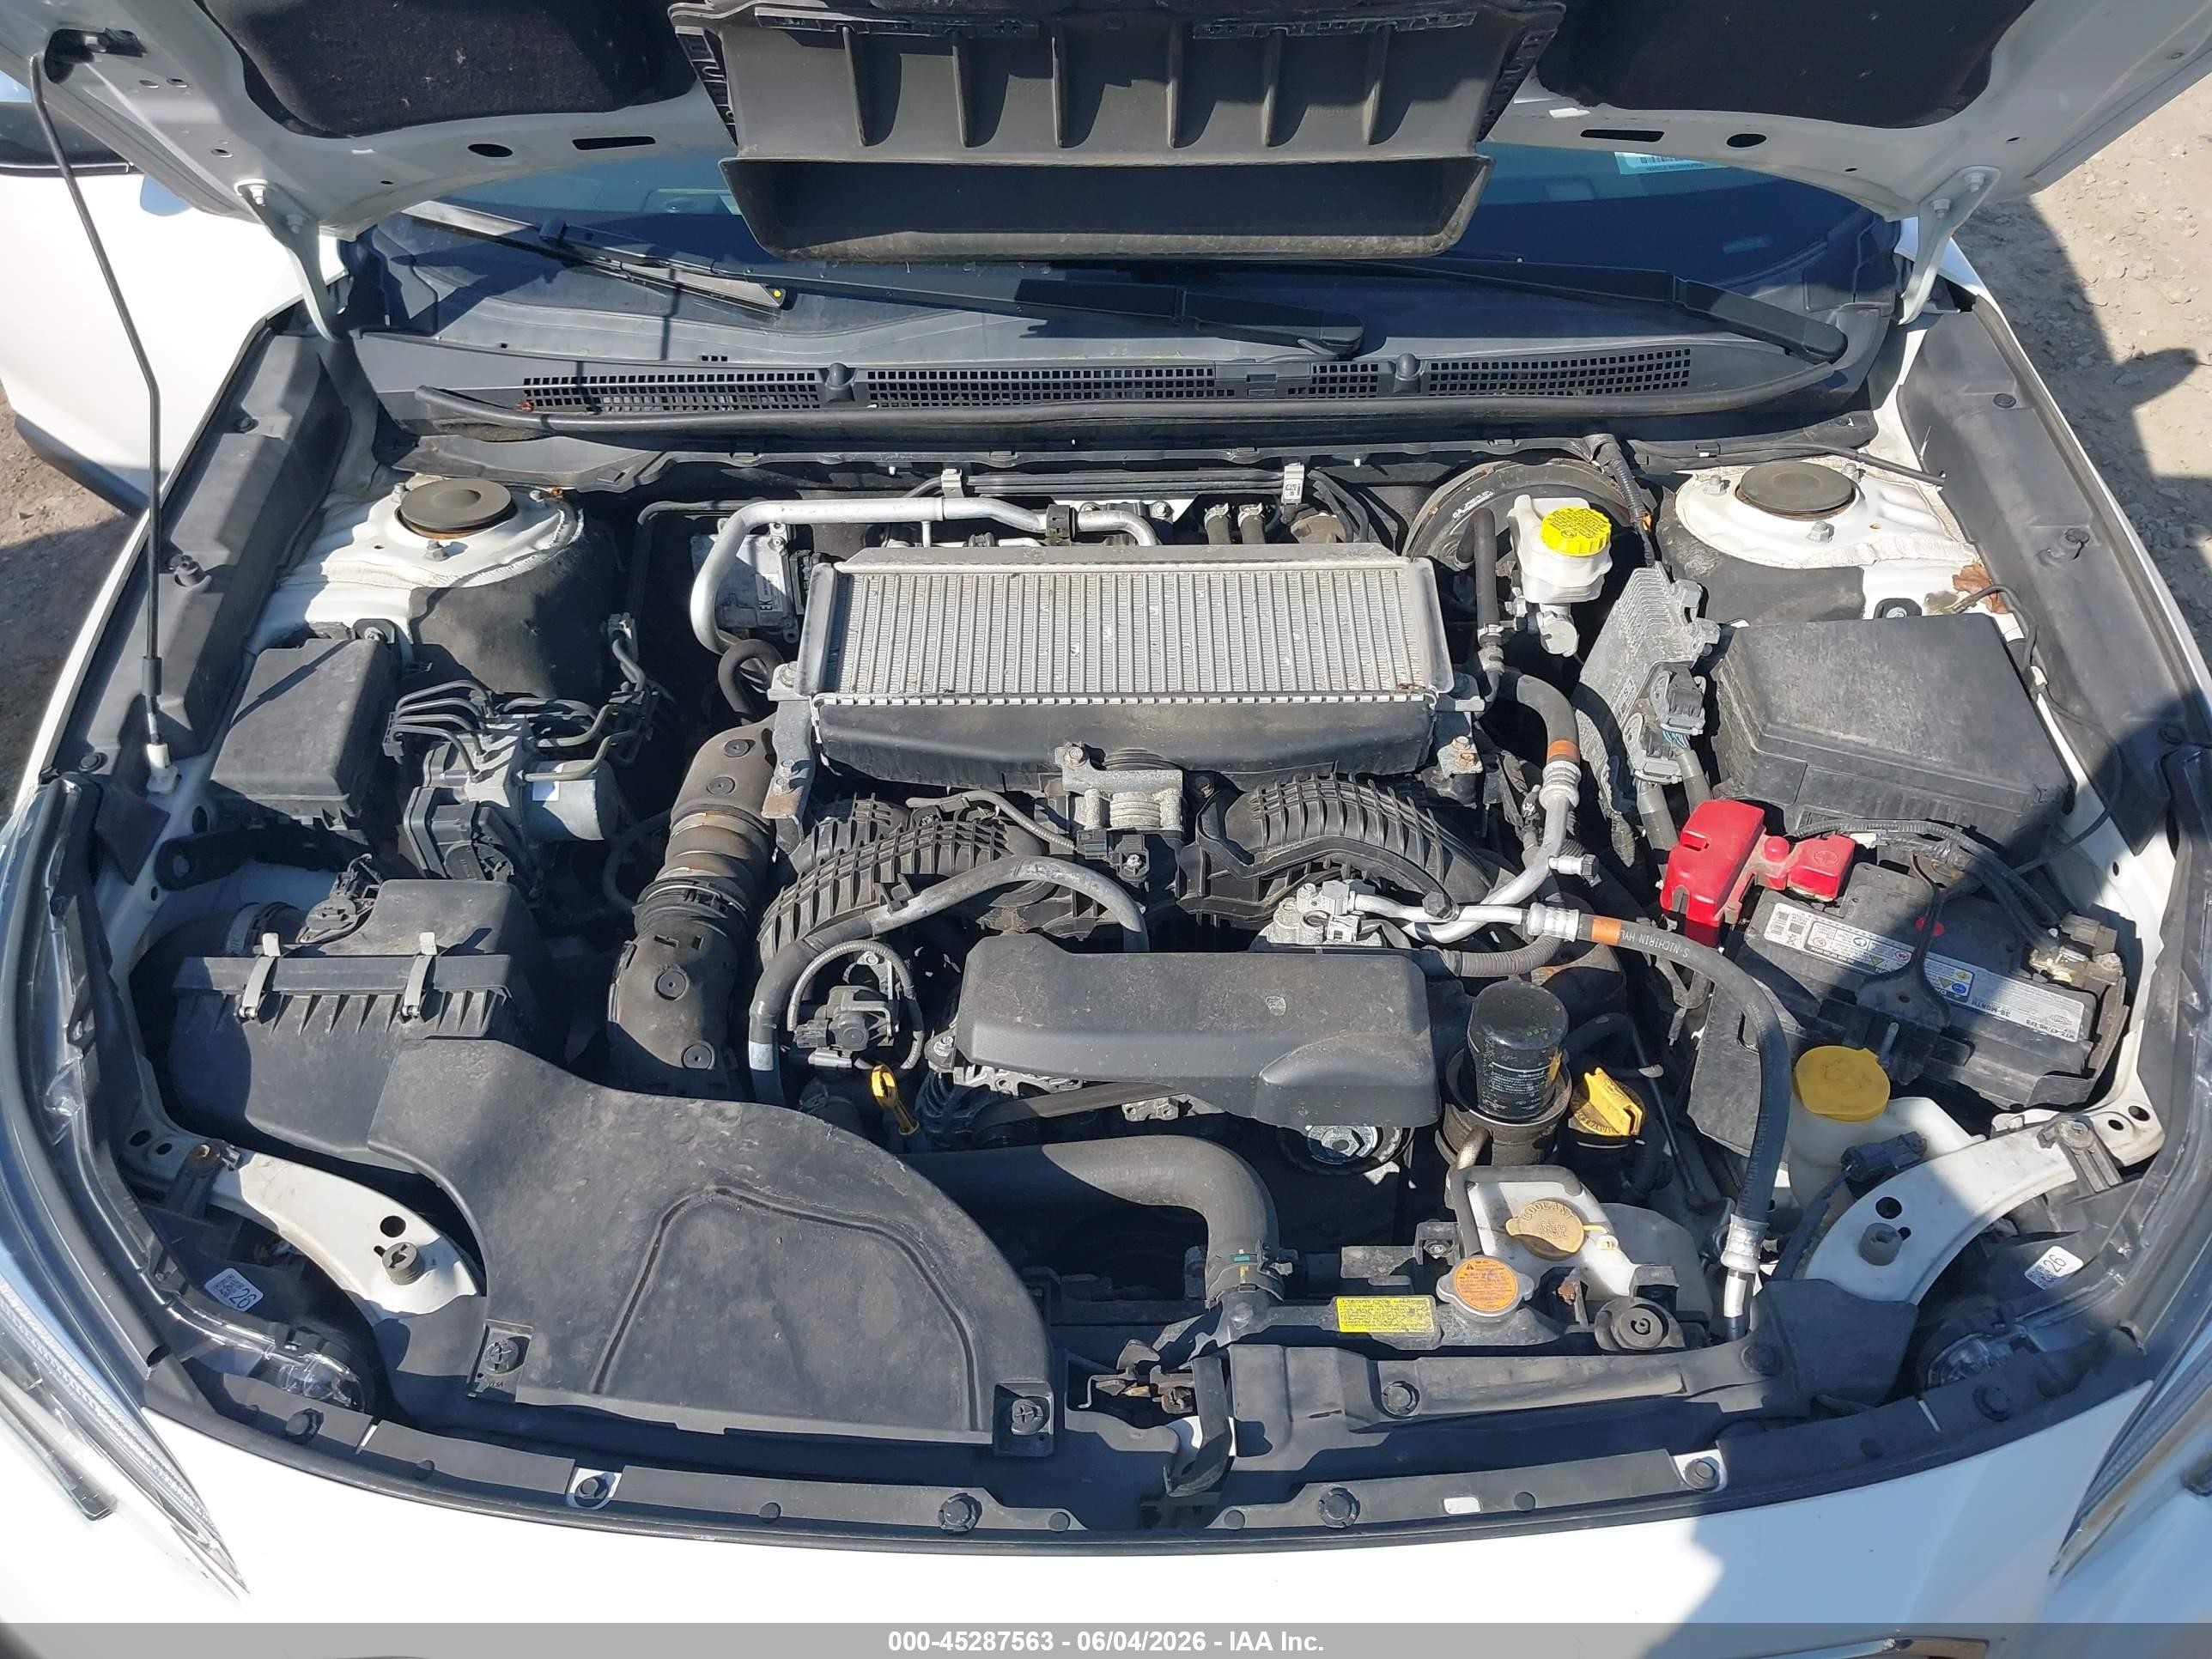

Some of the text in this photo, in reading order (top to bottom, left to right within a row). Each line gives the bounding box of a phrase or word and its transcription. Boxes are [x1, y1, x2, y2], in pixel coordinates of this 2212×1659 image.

[1638, 933, 1690, 958] S-NICHIRIN
[1522, 1201, 1575, 1221] COOLANT
[2043, 1254, 2067, 1273] 26
[229, 1288, 257, 1309] 26
